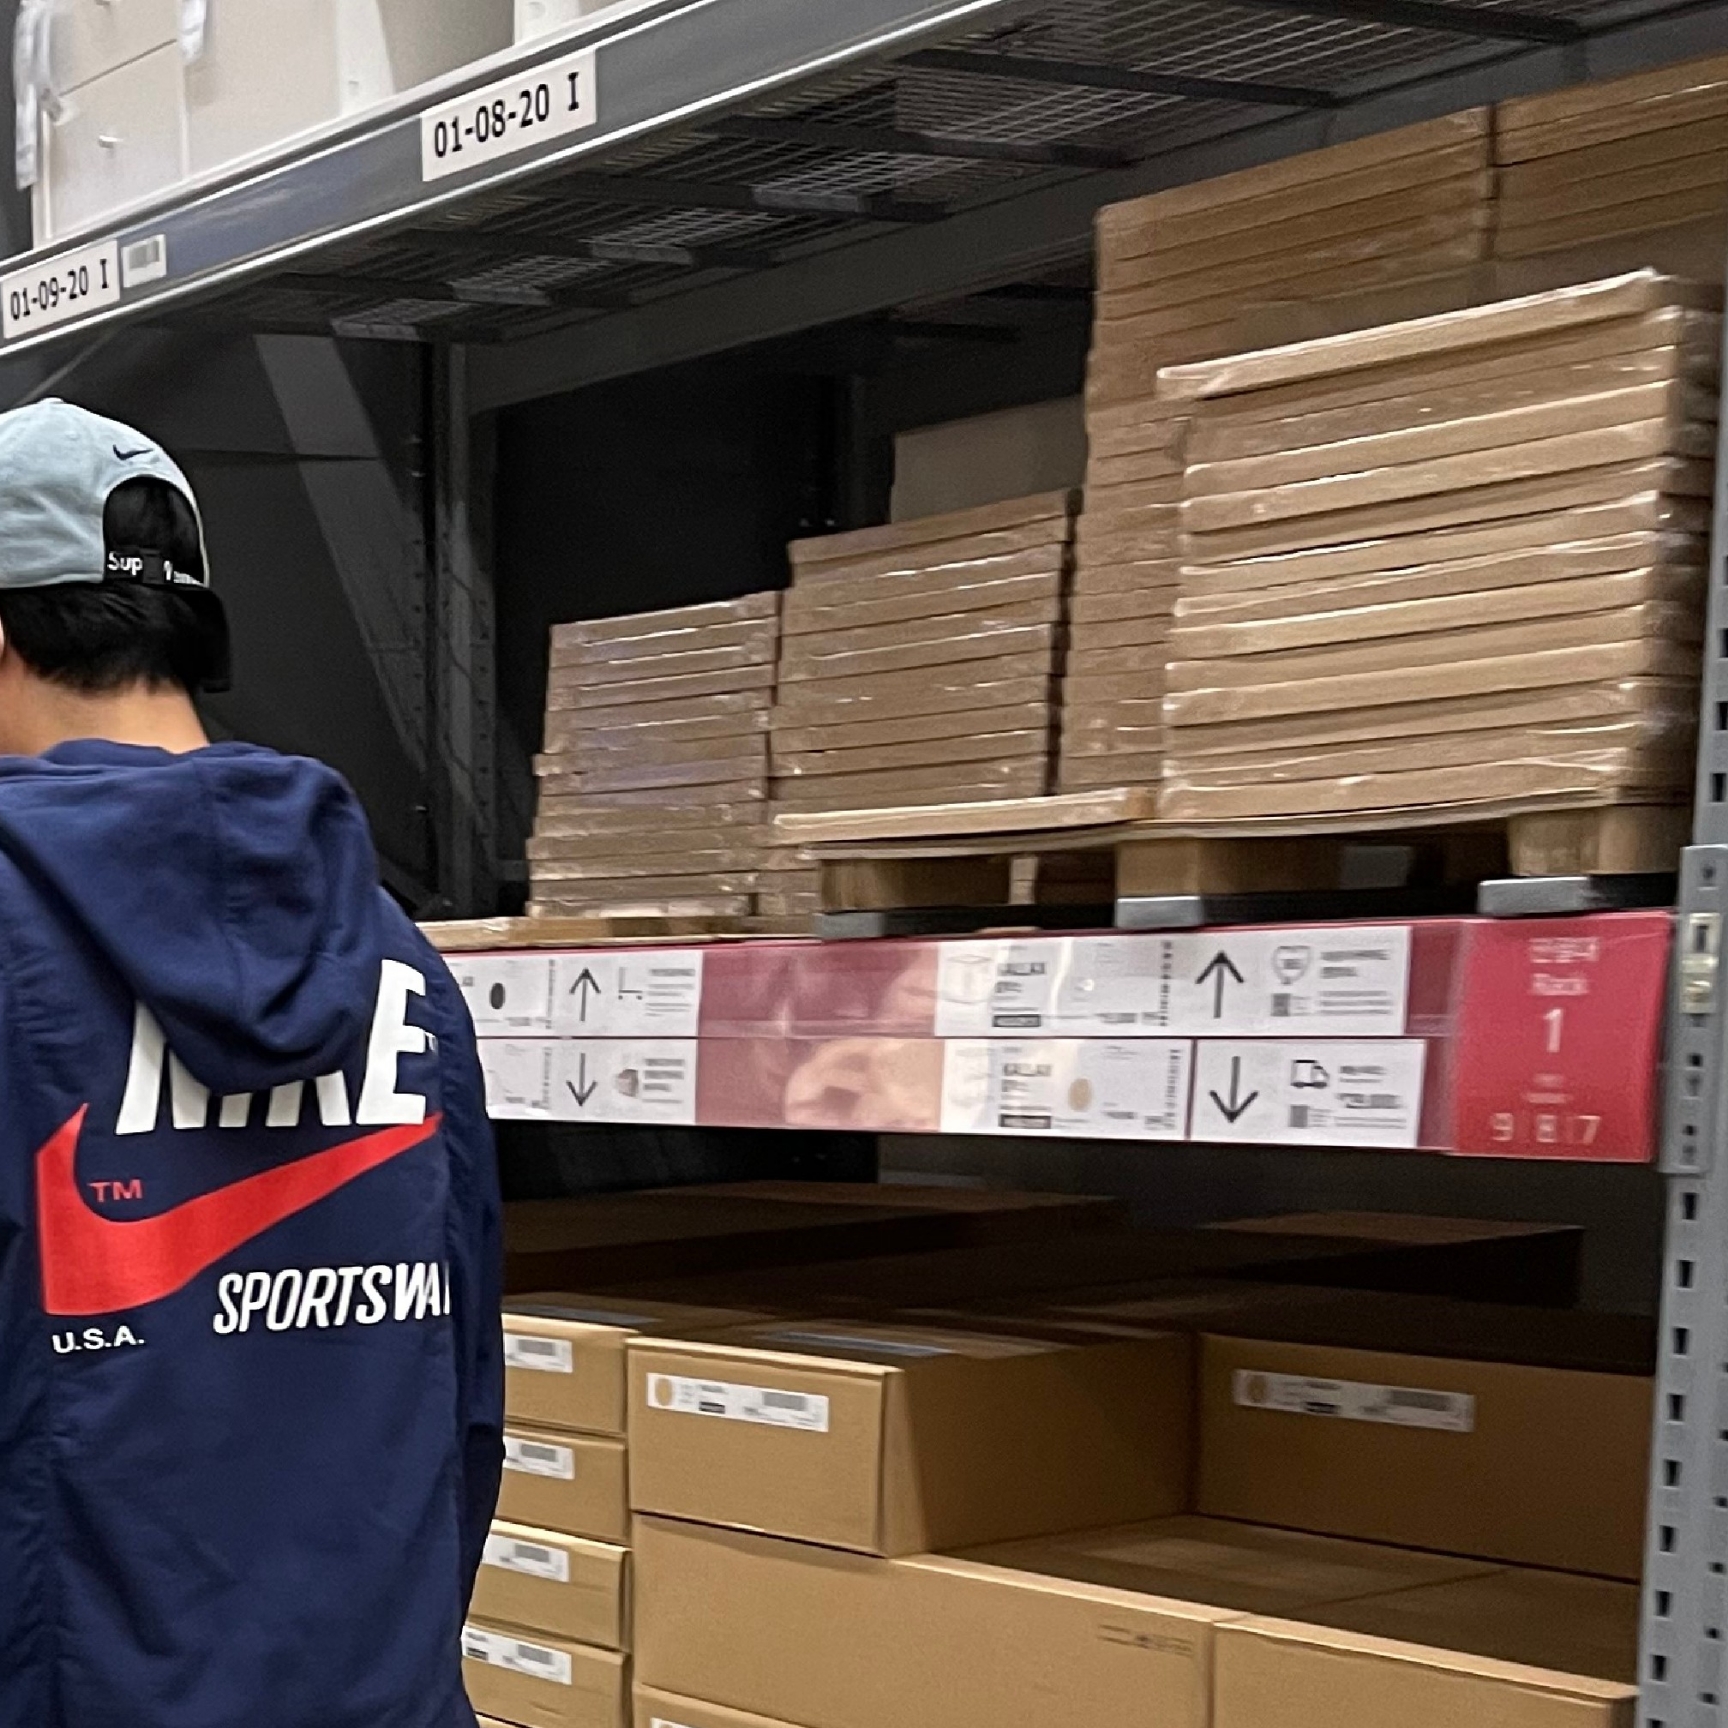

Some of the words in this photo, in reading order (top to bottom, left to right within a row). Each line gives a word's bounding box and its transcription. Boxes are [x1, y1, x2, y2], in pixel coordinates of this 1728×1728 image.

[434, 83, 550, 158] 01-08-20
[568, 71, 579, 112] I
[10, 265, 89, 320] 01-09-20
[100, 258, 109, 290] I
[1543, 1008, 1565, 1053] 1
[1576, 1114, 1602, 1145] 7
[87, 1178, 144, 1203] TM
[52, 1324, 146, 1354] U.S.A.
